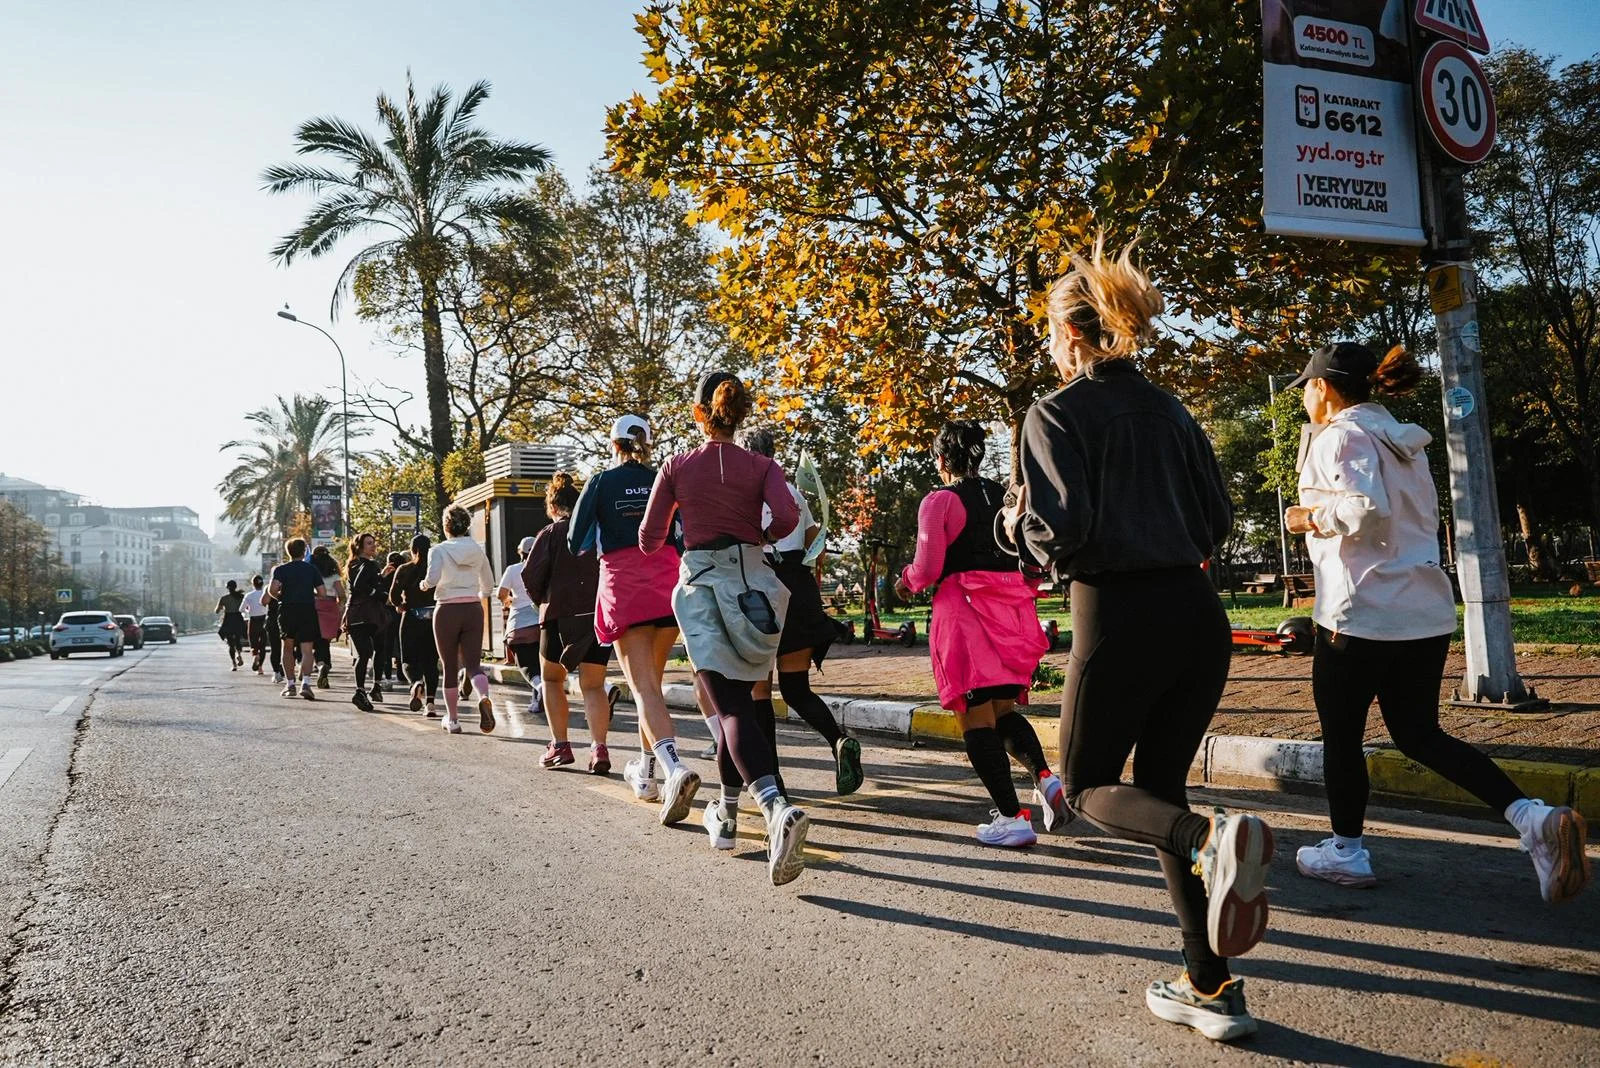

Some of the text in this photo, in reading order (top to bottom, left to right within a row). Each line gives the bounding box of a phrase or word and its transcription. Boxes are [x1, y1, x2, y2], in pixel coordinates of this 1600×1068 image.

[1303, 23, 1366, 50] 4500 TL
[1299, 43, 1325, 54] Katarakt
[1299, 94, 1315, 105] 100
[1324, 94, 1381, 110] KATARAKT
[1437, 69, 1482, 132] 30
[1324, 110, 1383, 137] 6612
[1296, 142, 1385, 169] yyd.org.tr
[1303, 174, 1387, 198] YERYÜZÜ
[1303, 193, 1388, 213] DOKTORLARI
[625, 487, 652, 495] DUS
